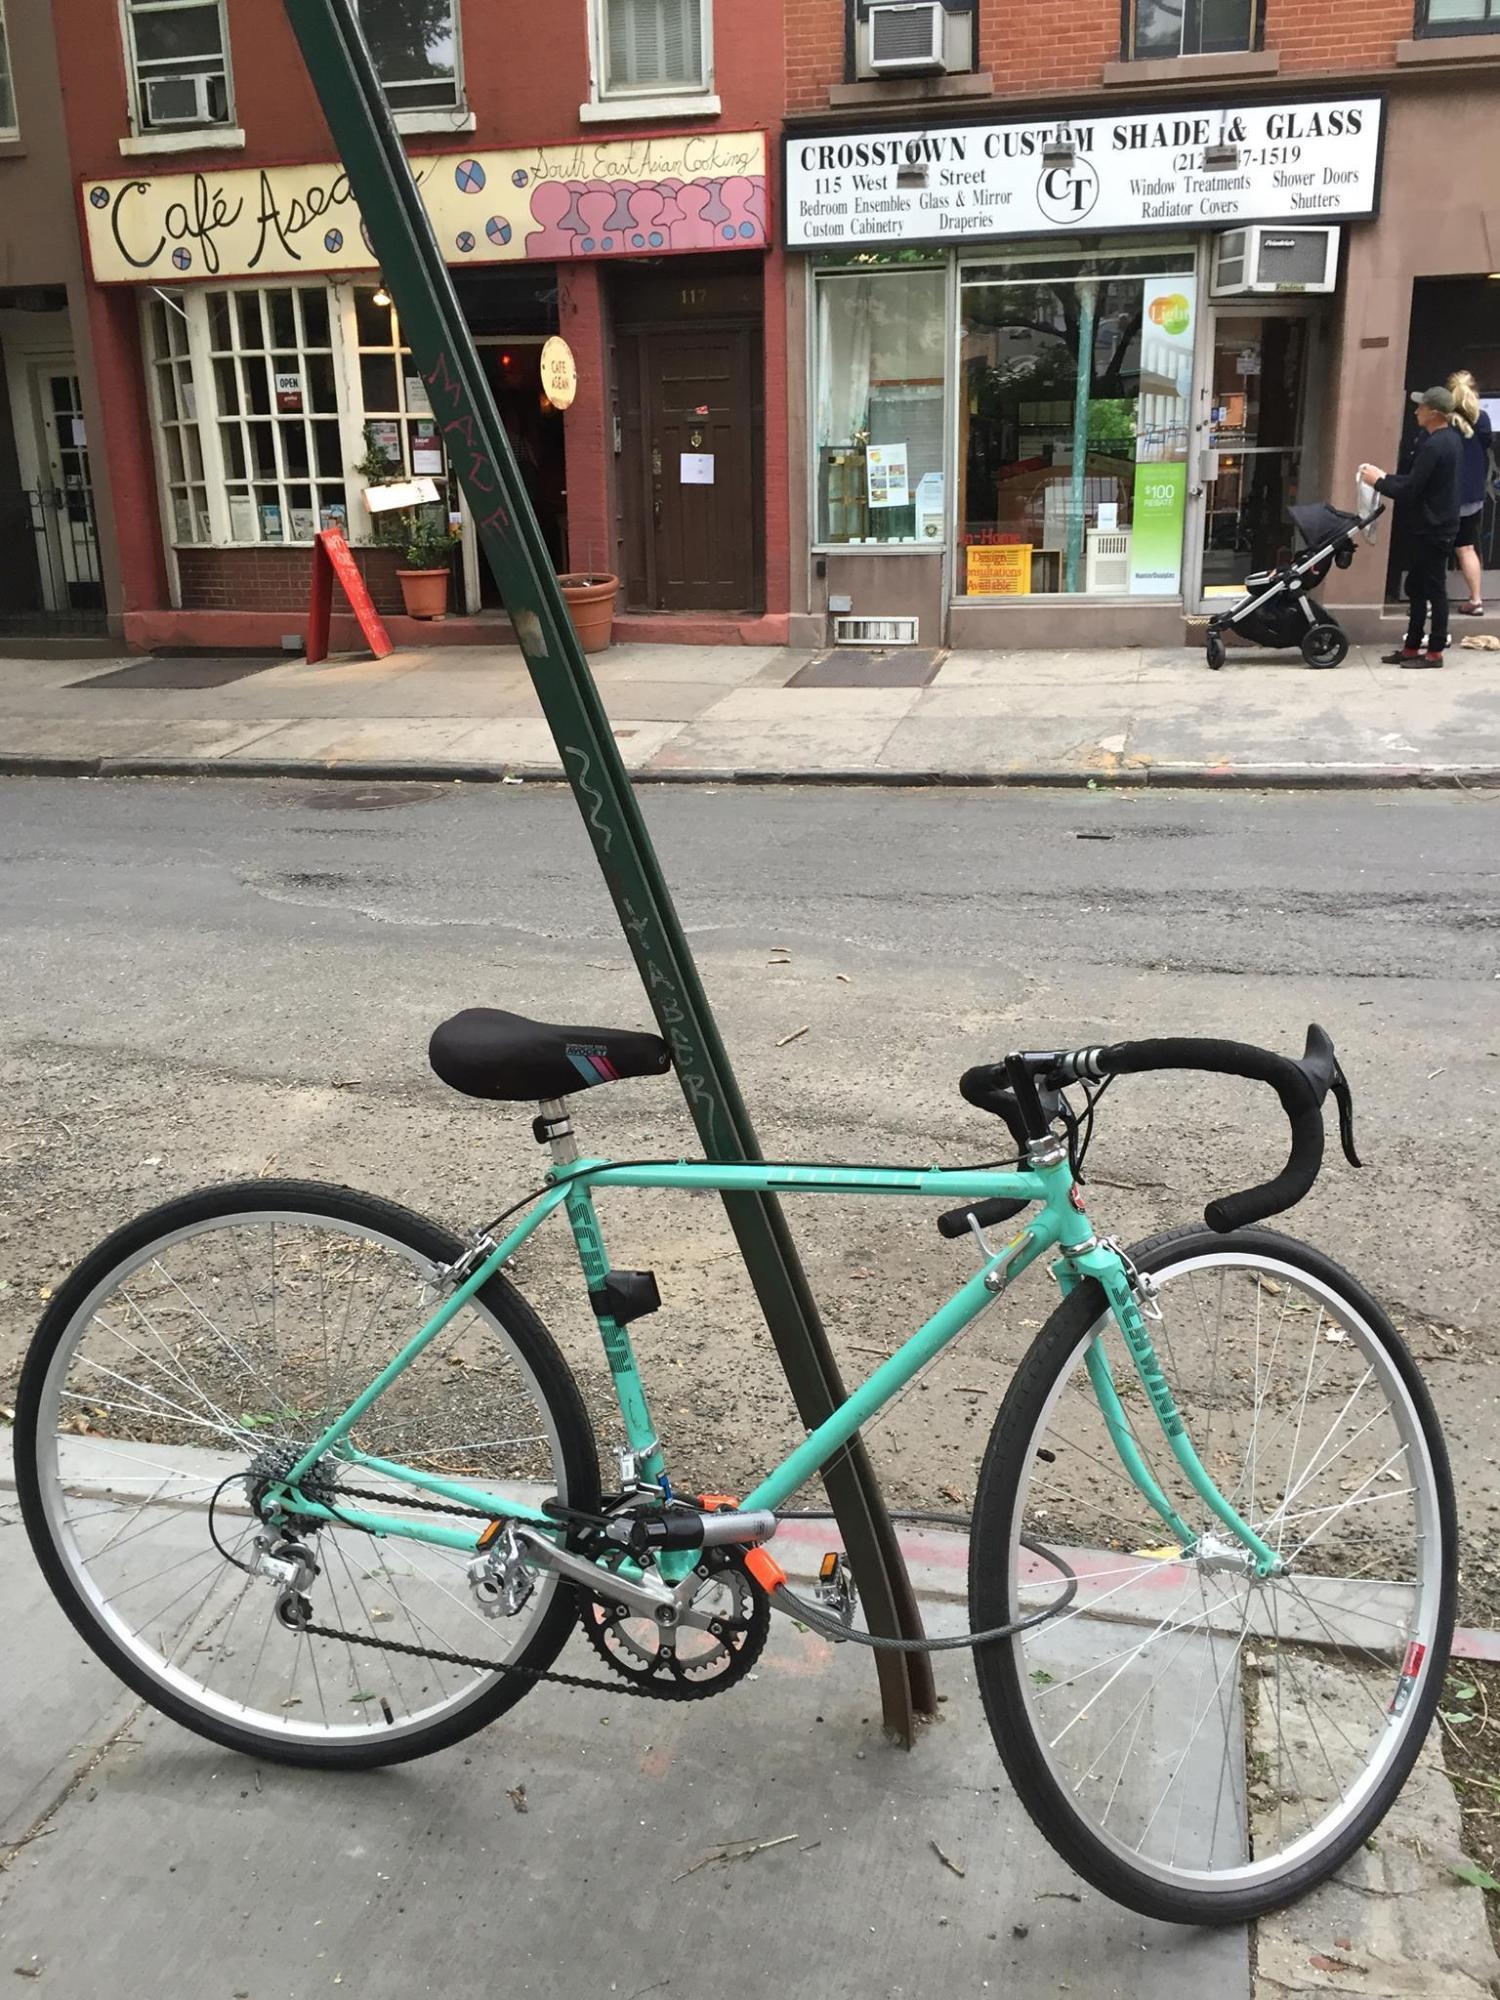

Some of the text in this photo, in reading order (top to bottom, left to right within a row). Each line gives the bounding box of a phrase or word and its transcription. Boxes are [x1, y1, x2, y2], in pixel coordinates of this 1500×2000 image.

[801, 109, 1364, 171] CROSSTOWN CUSTOM SHADE & GLASS
[530, 137, 759, 187] South East Asian Cooking
[815, 168, 986, 195] 115 West Street
[1044, 167, 1093, 211] CT
[1130, 167, 1360, 197] Window Treatments Shower Doors
[799, 188, 1013, 217] Bedroom Ensembles Glass & Mirror
[1141, 192, 1342, 219] Radiator Covers Shutters
[111, 173, 243, 274] Café
[803, 211, 994, 238] Custom Cabinetry Draperies
[681, 289, 707, 304] 117
[280, 377, 299, 389] OPEN
[1144, 484, 1175, 499] $100
[571, 1203, 632, 1374] SCHNN
[1111, 1284, 1186, 1438] SCHWINN
